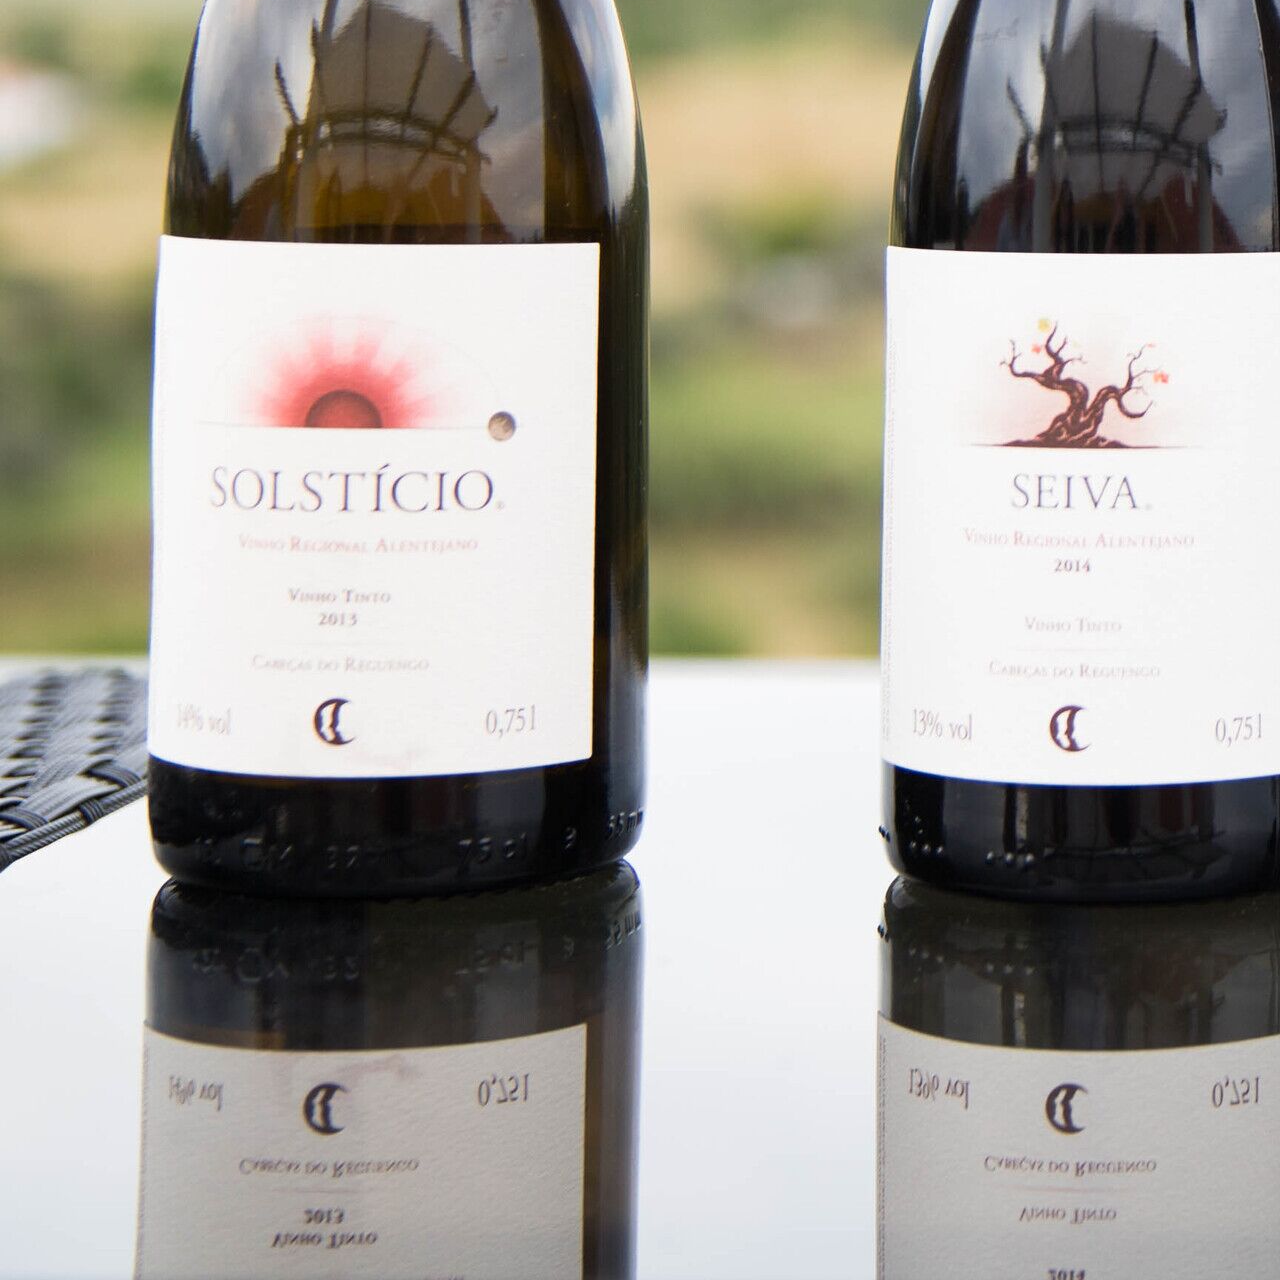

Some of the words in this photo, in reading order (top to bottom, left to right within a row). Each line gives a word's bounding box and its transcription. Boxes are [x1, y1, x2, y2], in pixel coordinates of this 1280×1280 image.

[209, 463, 495, 513] SOLSTÍCIO
[1011, 473, 1139, 510] SEIVA
[1053, 558, 1092, 573] 2014
[317, 612, 359, 627] 2013
